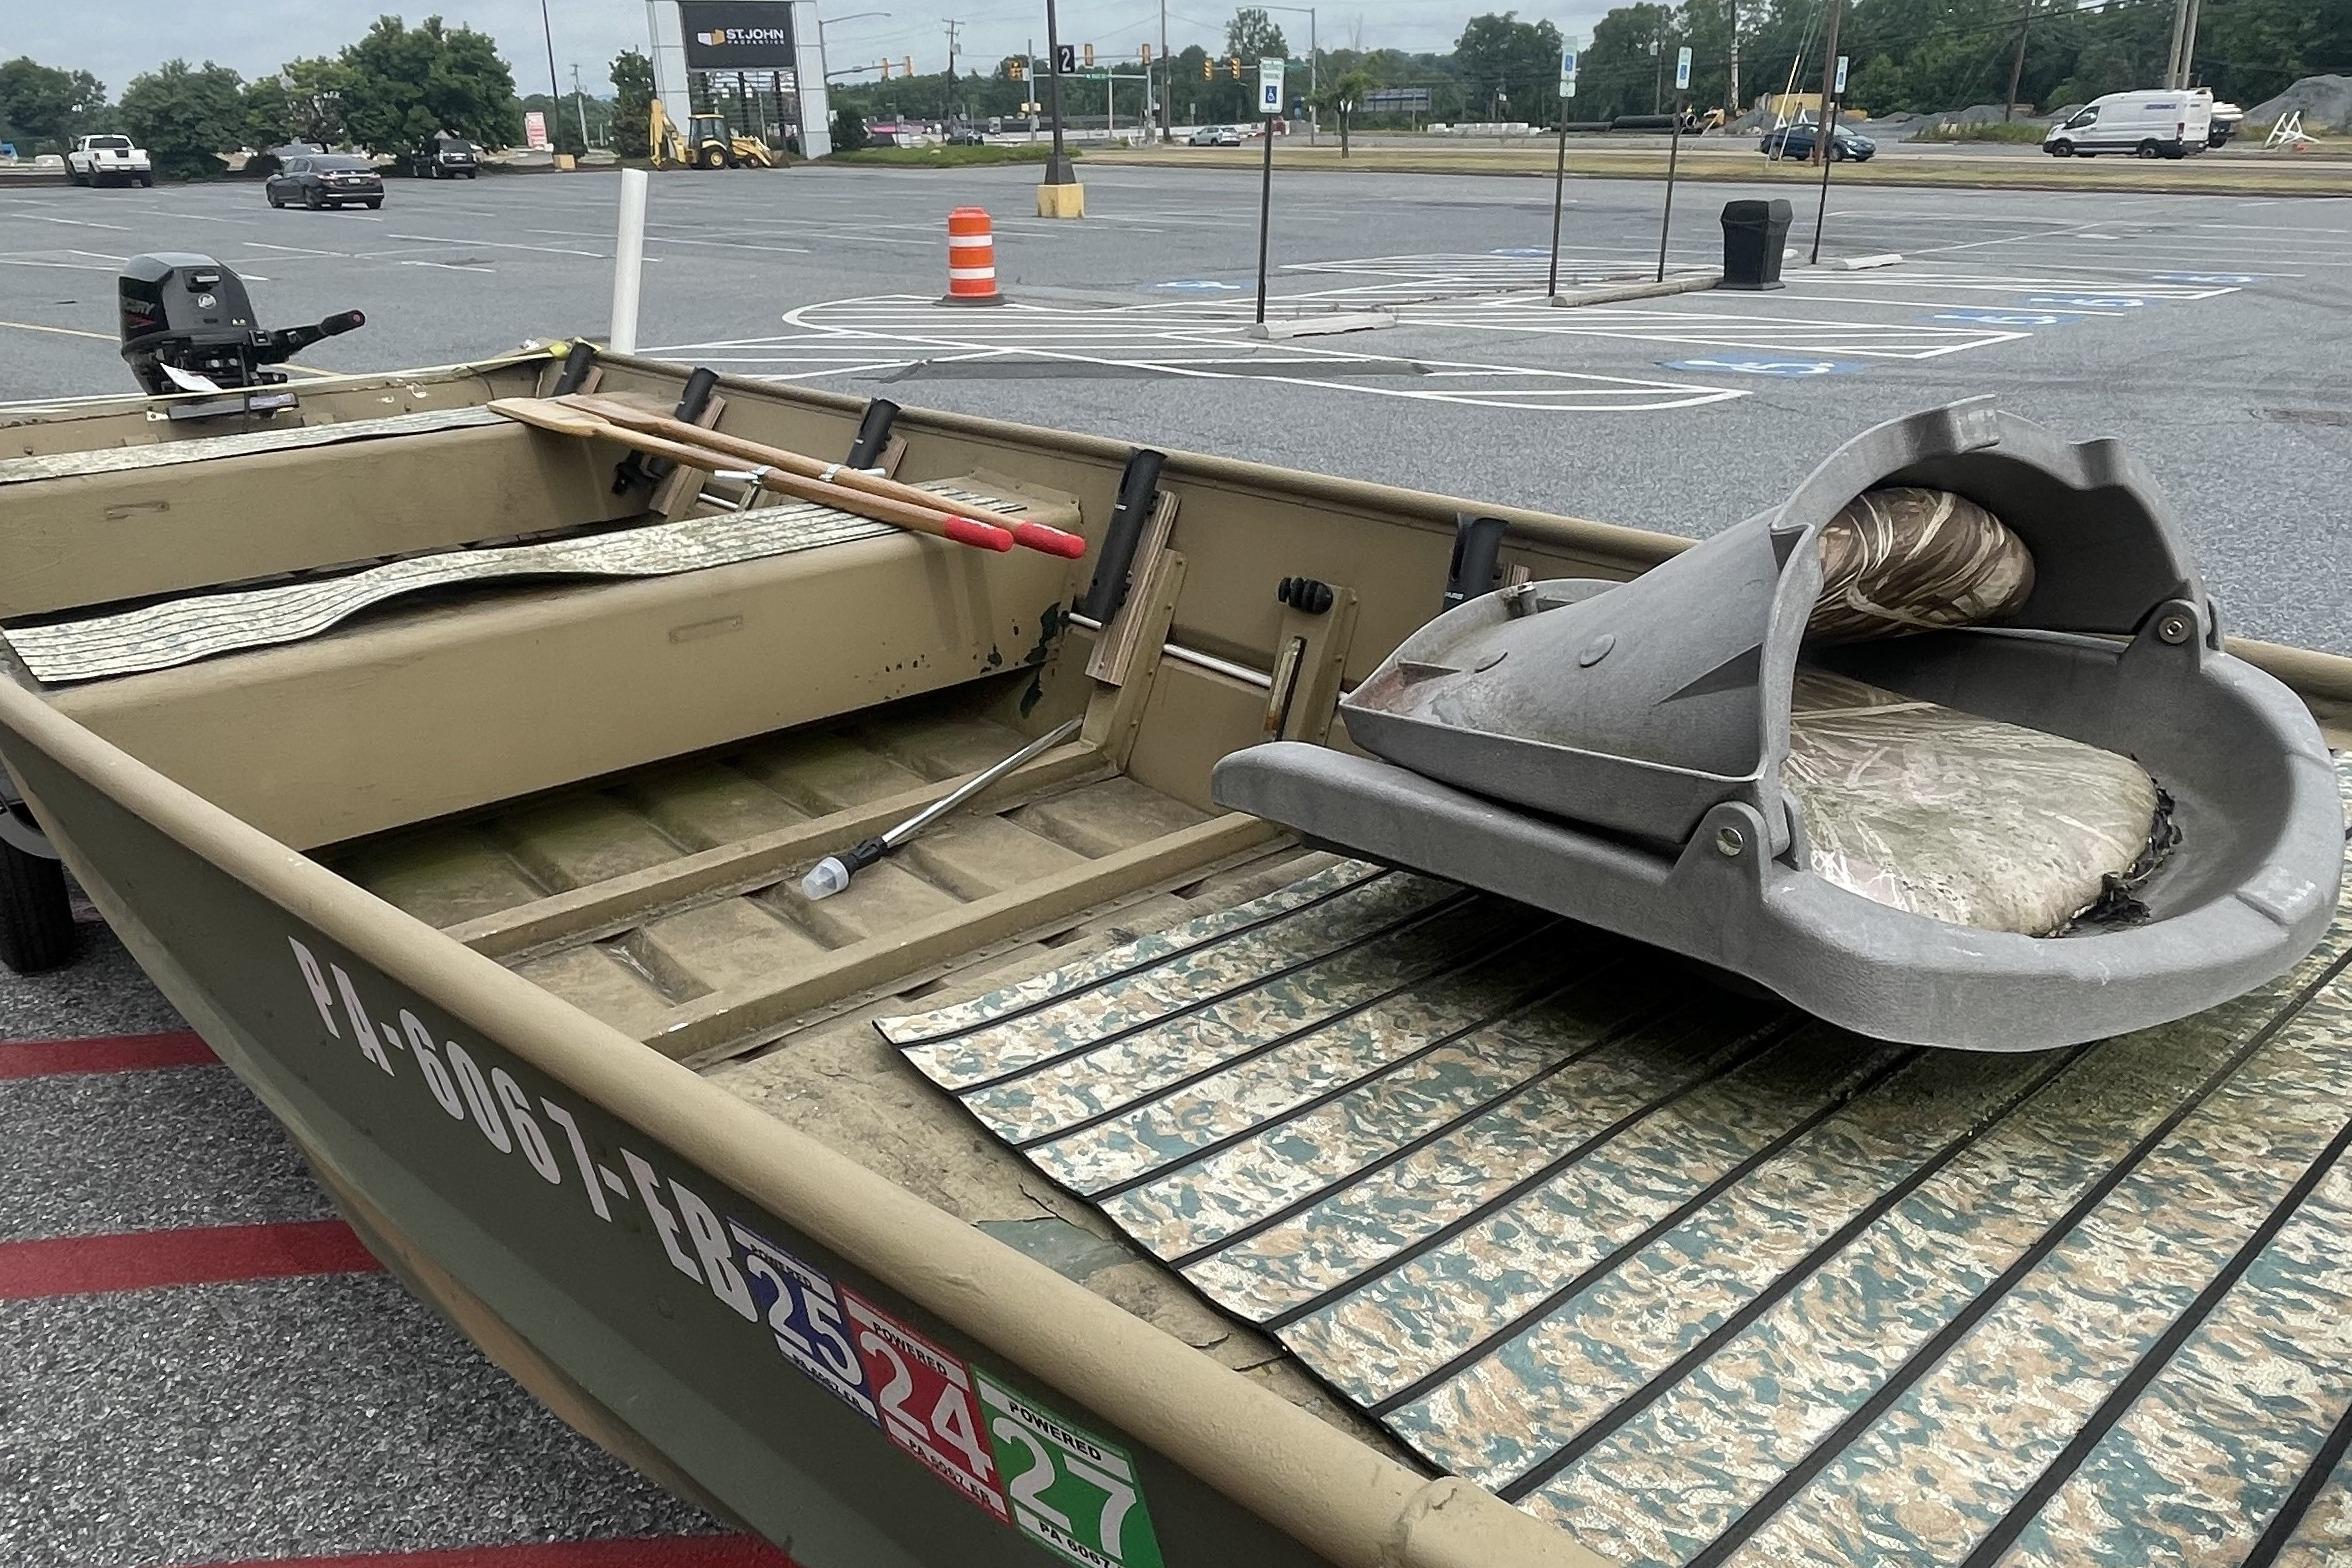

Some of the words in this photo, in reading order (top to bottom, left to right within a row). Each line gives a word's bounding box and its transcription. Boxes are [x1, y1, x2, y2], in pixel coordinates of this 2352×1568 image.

[1061, 47, 1071, 72] 2
[746, 1254, 863, 1386] 25
[872, 1321, 948, 1376] POWERED
[860, 1330, 994, 1482] 24
[1009, 1401, 1102, 1462] POWERED
[992, 1416, 1137, 1560] 27
[1038, 1520, 1063, 1544] PA
[1067, 1539, 1111, 1568] 6067
